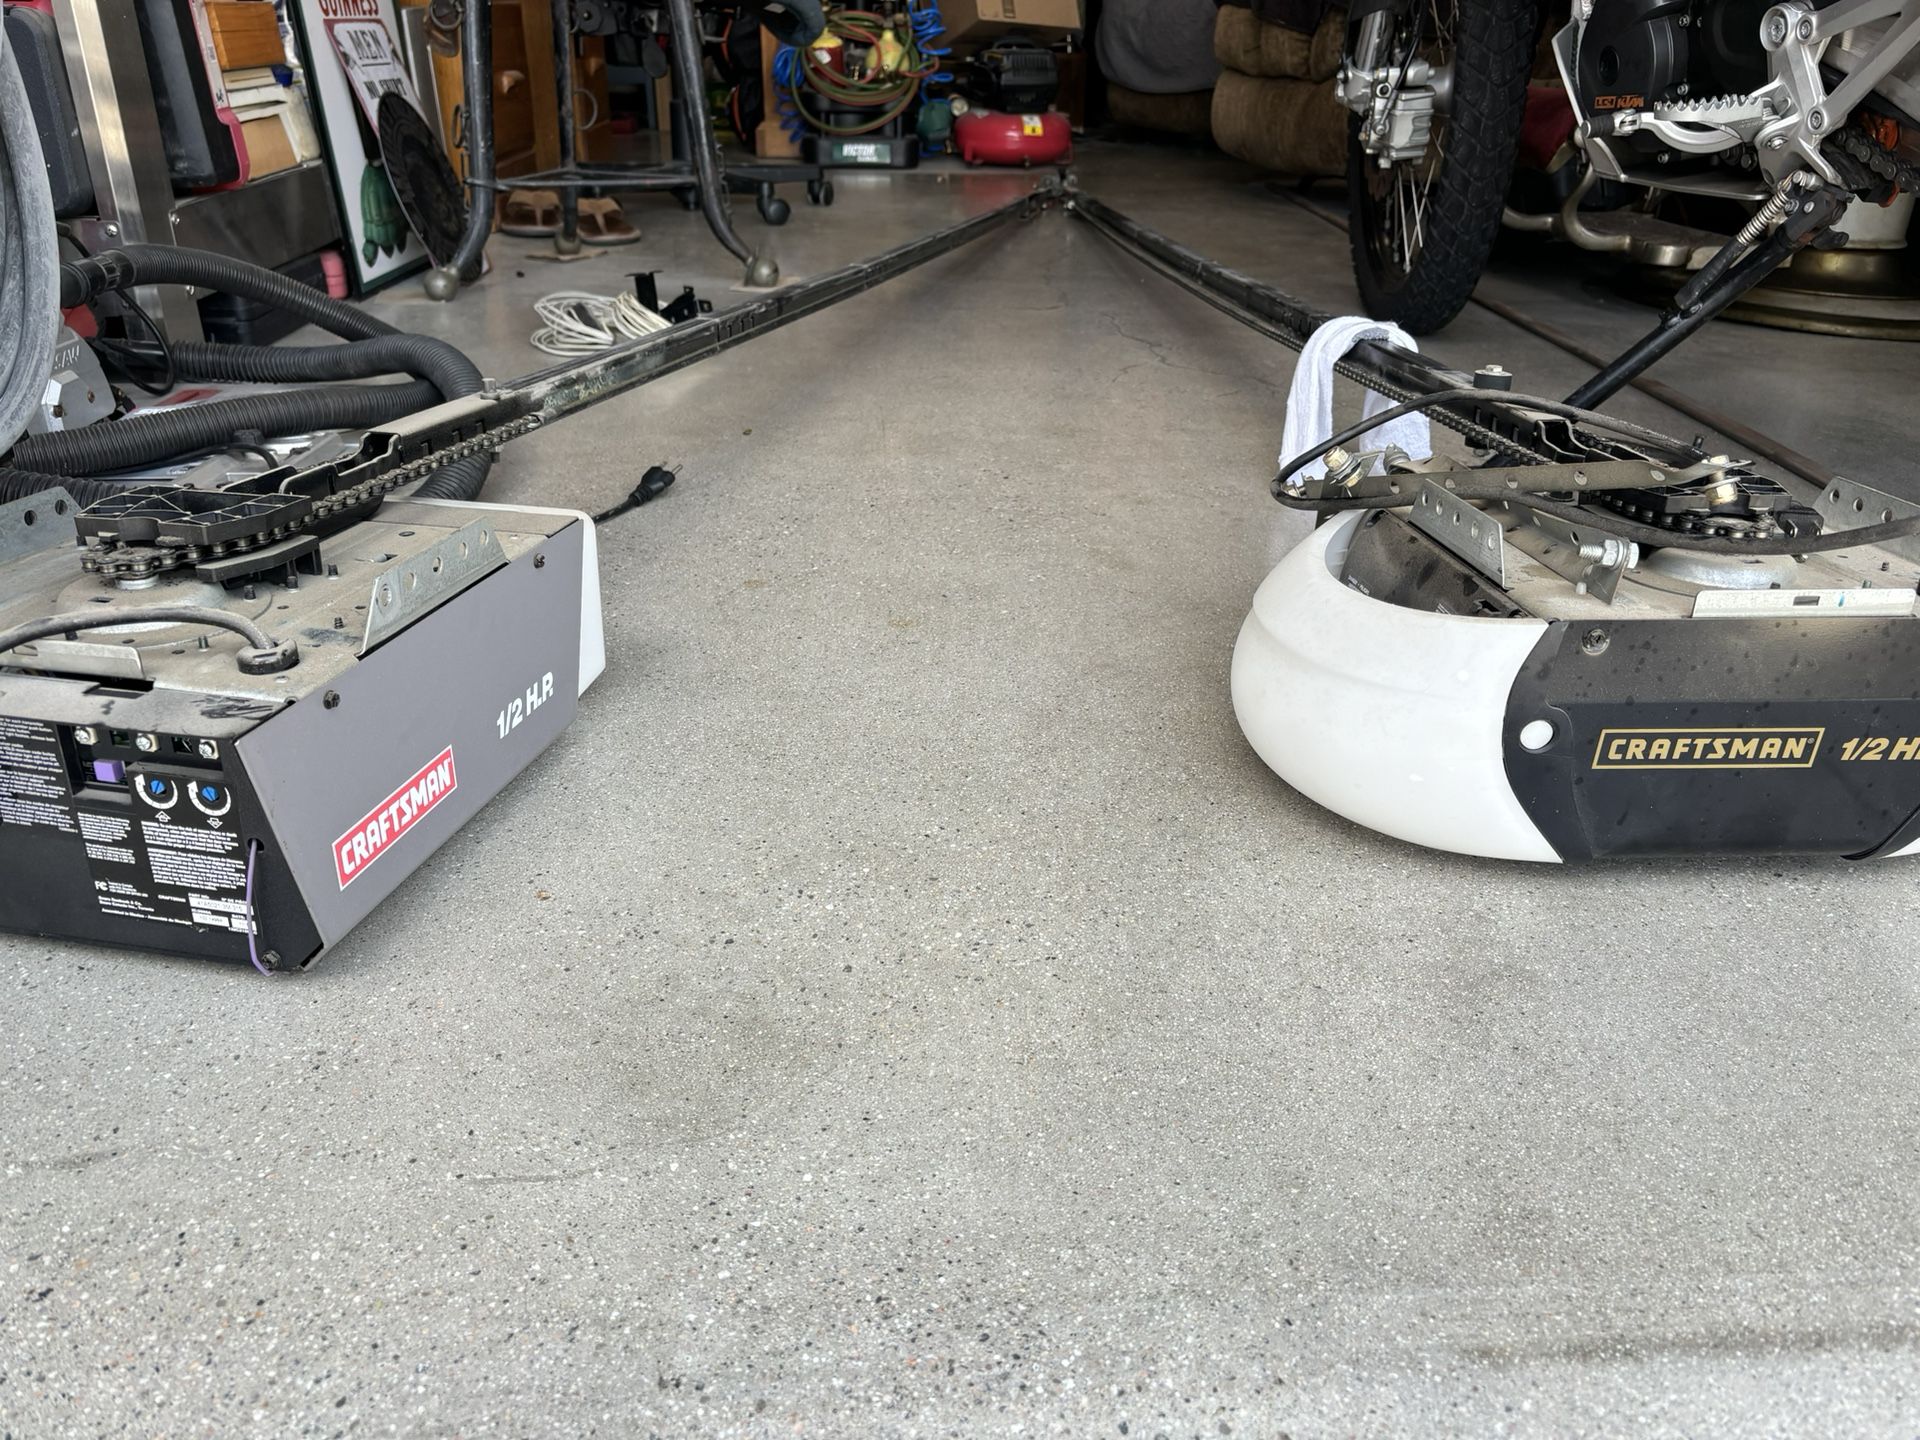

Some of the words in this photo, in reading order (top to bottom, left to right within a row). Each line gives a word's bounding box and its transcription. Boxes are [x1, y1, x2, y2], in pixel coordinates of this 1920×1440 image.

[346, 30, 388, 60] MEN
[1617, 95, 1644, 108] KTM
[497, 697, 523, 740] 1/2
[1607, 738, 1808, 760] CRAFTSMAN
[1840, 737, 1890, 760] 1/2
[341, 757, 451, 875] CRAFTSMAN
